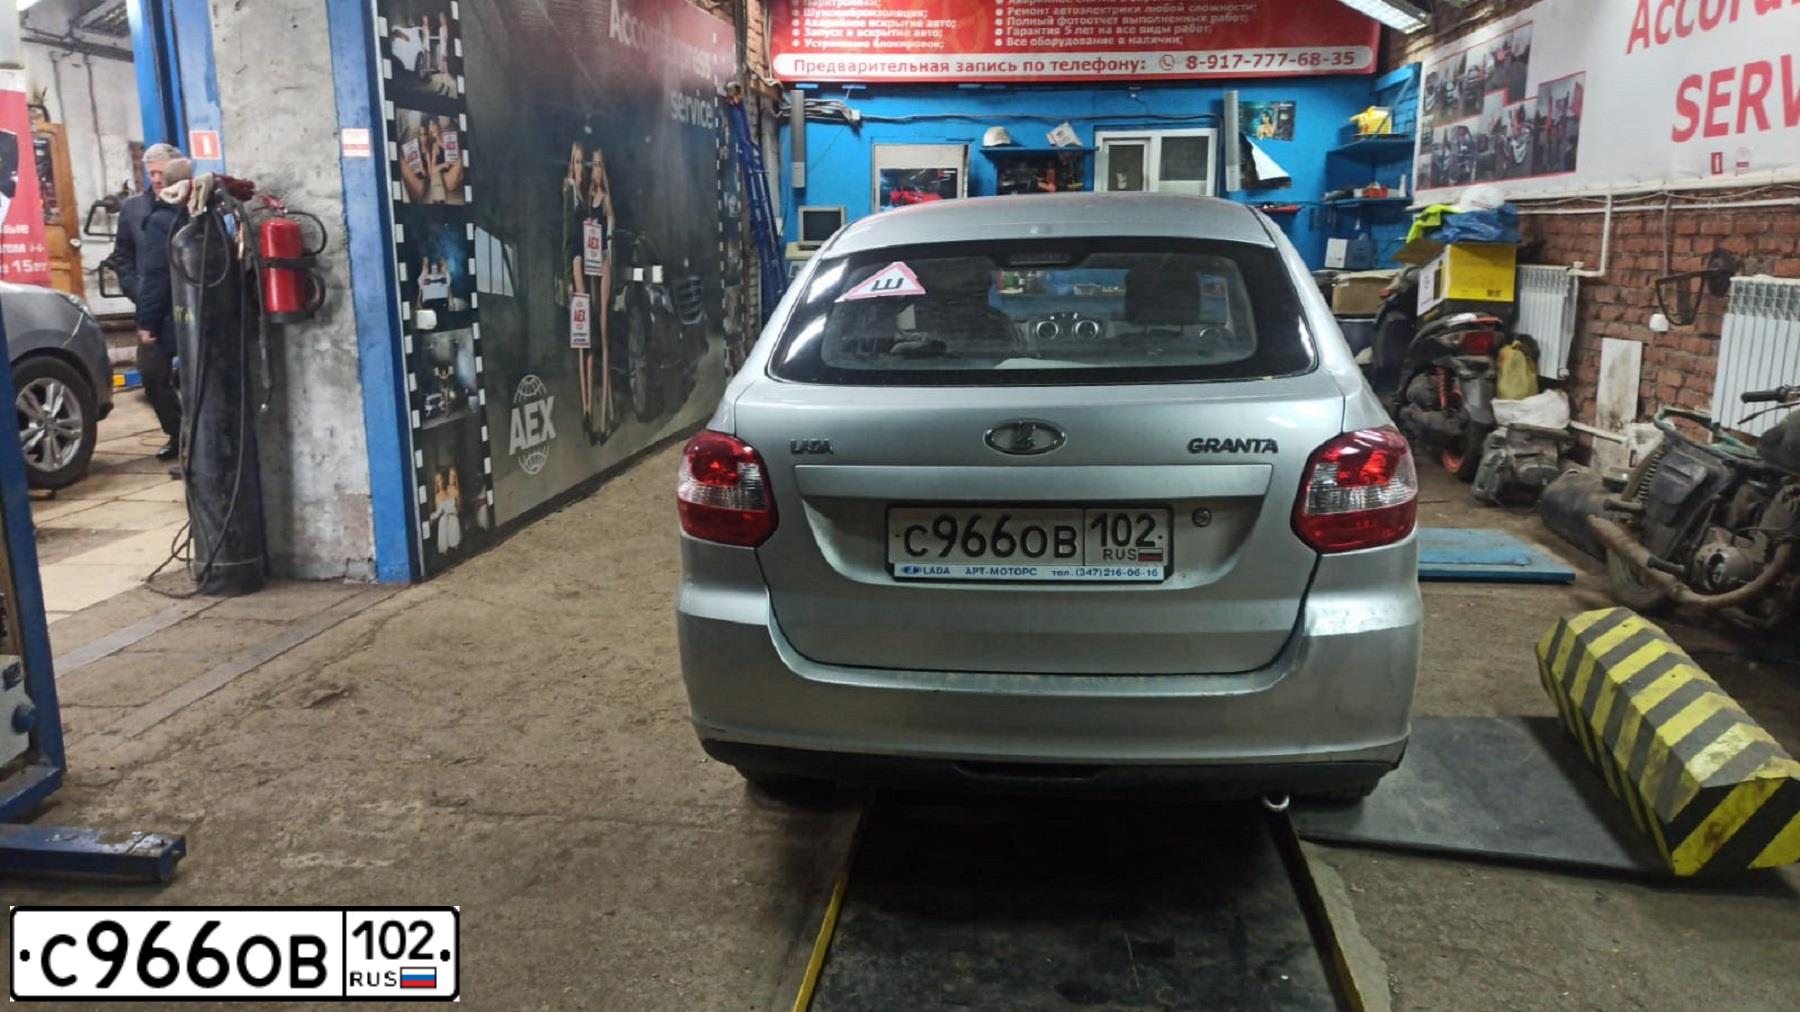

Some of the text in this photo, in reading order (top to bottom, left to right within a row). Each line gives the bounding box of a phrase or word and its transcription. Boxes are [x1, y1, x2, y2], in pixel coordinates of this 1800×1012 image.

[1007, 7, 1049, 16] Ремонт
[1007, 16, 1054, 25] Полный
[1007, 26, 1060, 36] Гарантия
[1064, 26, 1072, 35] 5
[1075, 27, 1094, 35] лет
[1007, 37, 1027, 46] Все
[794, 51, 1355, 74] Предварительная запись по телефону: 8-917-777-68-35
[509, 396, 556, 456] AEX
[1187, 437, 1279, 454] GRANTA
[1090, 512, 1156, 548] 102
[1102, 549, 1137, 561] RUS
[923, 566, 951, 576] LADA
[964, 567, 1037, 576] АРТ-МОТОРС
